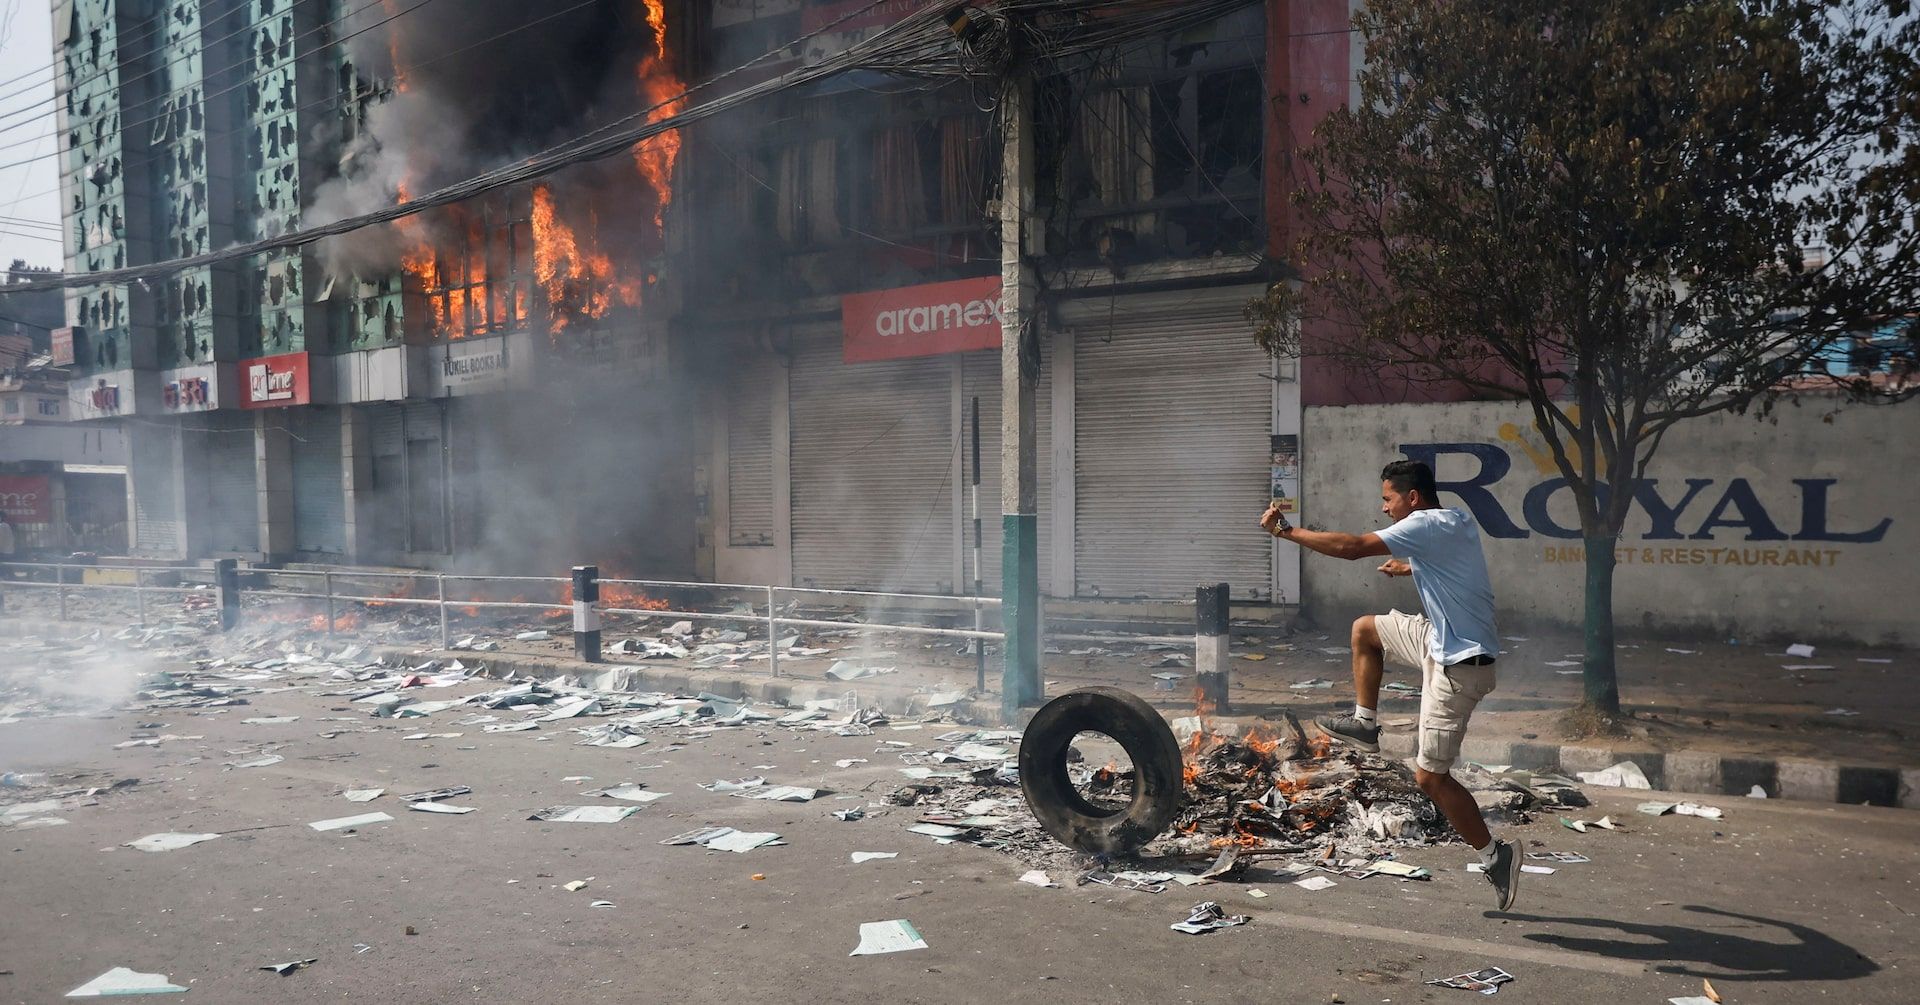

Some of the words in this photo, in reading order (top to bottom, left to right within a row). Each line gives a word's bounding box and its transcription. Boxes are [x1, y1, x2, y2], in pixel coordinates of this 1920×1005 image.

[1544, 546, 1638, 564] BANET
[1642, 547, 1655, 564] &
[1660, 548, 1841, 567] RESTAURANT
